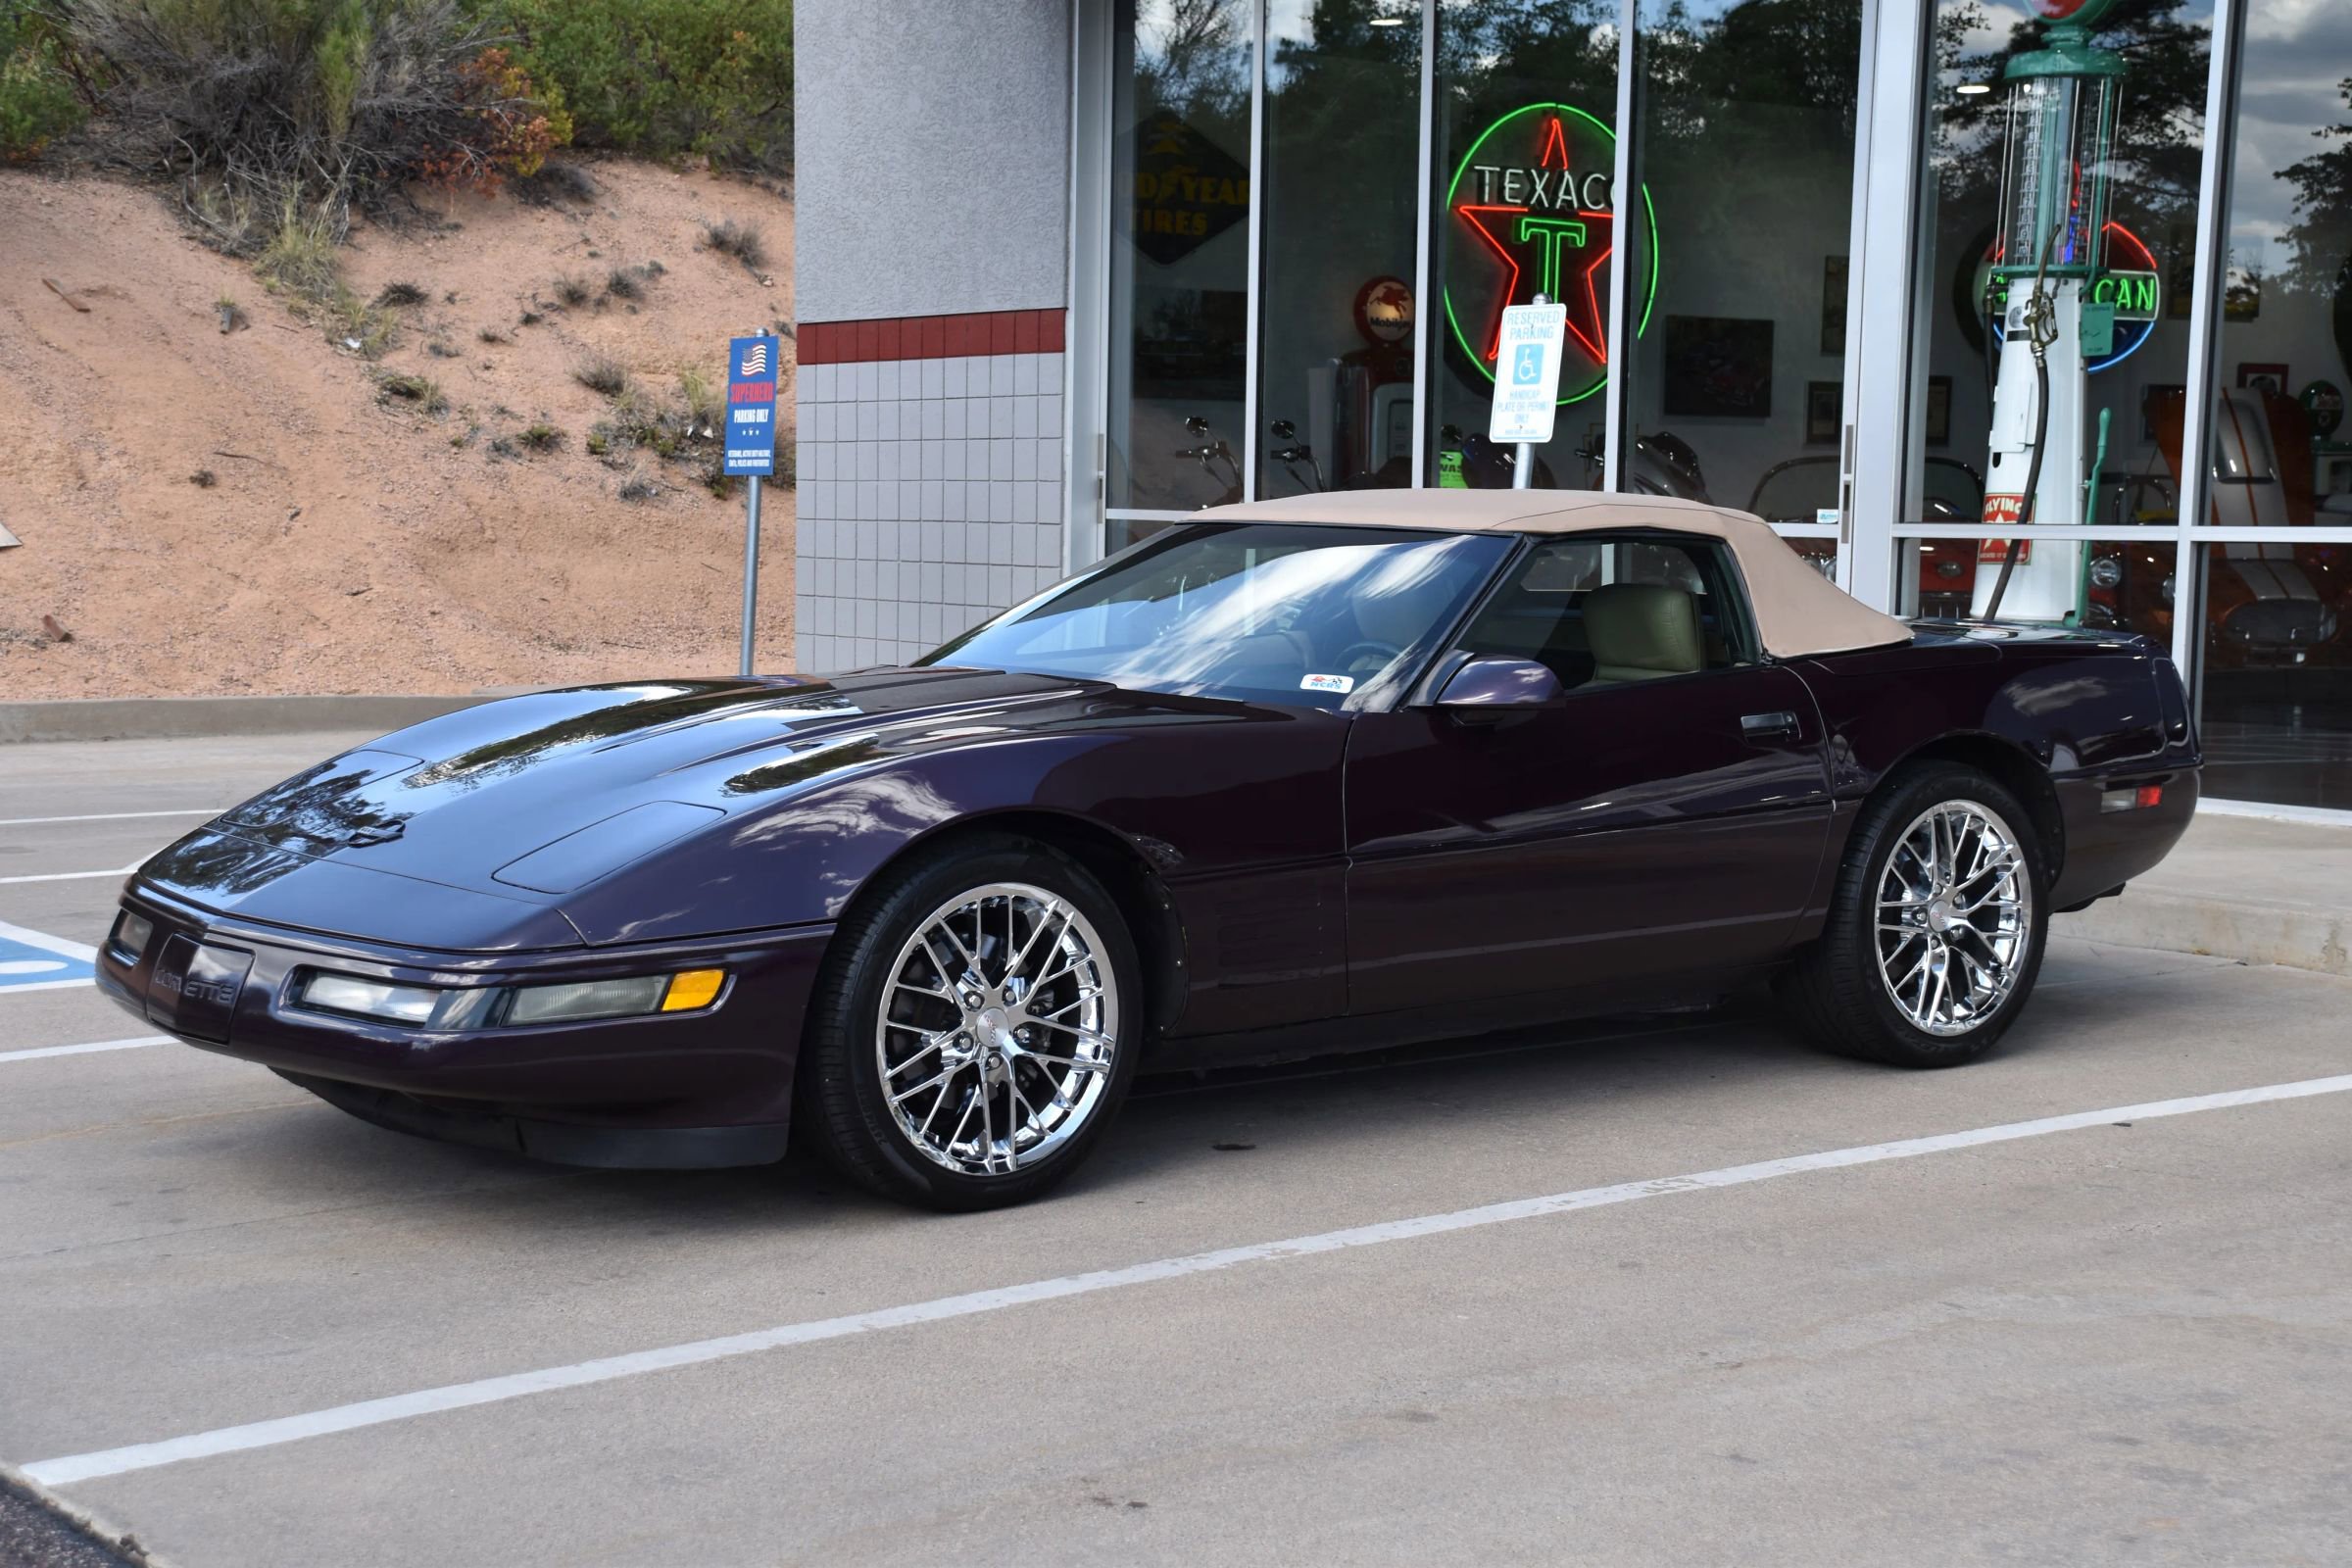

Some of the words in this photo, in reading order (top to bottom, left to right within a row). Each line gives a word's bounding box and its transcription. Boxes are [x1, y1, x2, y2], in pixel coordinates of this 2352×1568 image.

[1474, 165, 1615, 211] TEXAC
[1521, 218, 1587, 304] T
[1507, 311, 1559, 325] RESERVED
[1509, 325, 1553, 340] PARKING
[730, 382, 773, 403] SUPERHERO
[734, 409, 756, 423] PARKING
[756, 408, 769, 422] ONLY
[155, 969, 236, 1004] CORETTE
